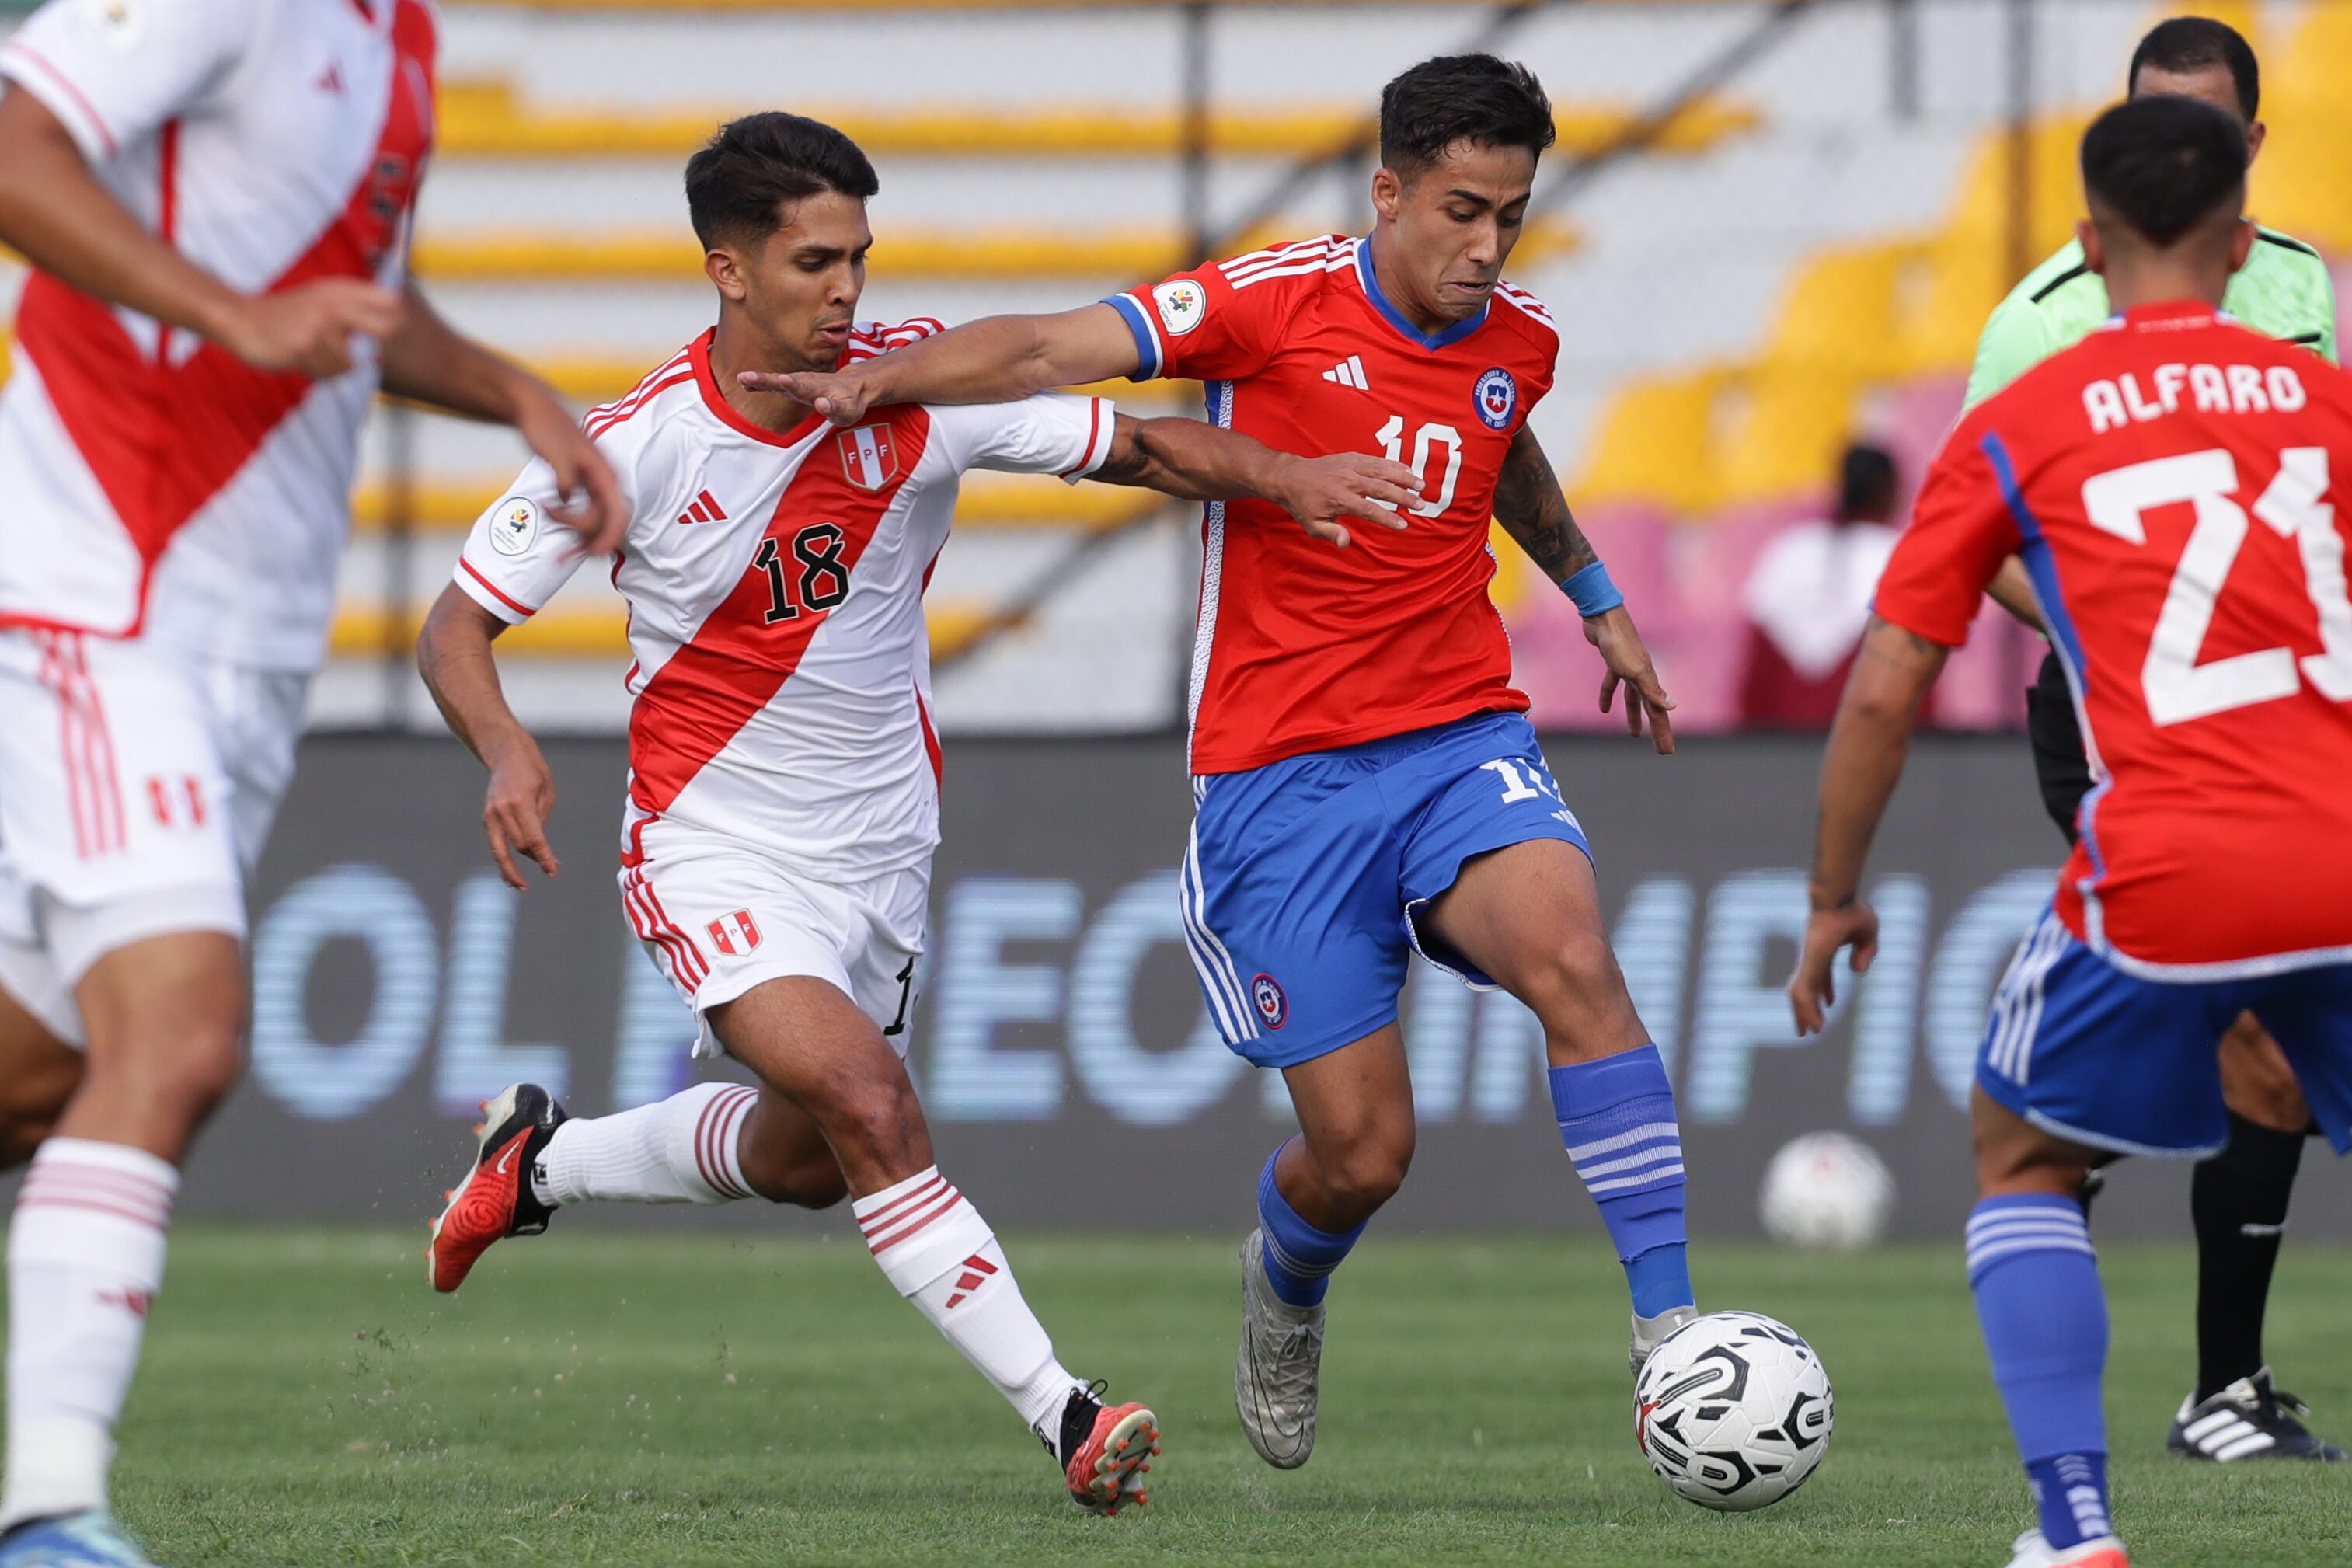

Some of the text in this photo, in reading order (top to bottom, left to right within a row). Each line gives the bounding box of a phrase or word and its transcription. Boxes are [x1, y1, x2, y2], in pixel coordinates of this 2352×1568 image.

[2082, 363, 2307, 434] ALFARO
[1365, 414, 1462, 519] 10
[752, 522, 850, 625] 18
[2081, 446, 2352, 727] 21
[883, 955, 918, 1036] 1
